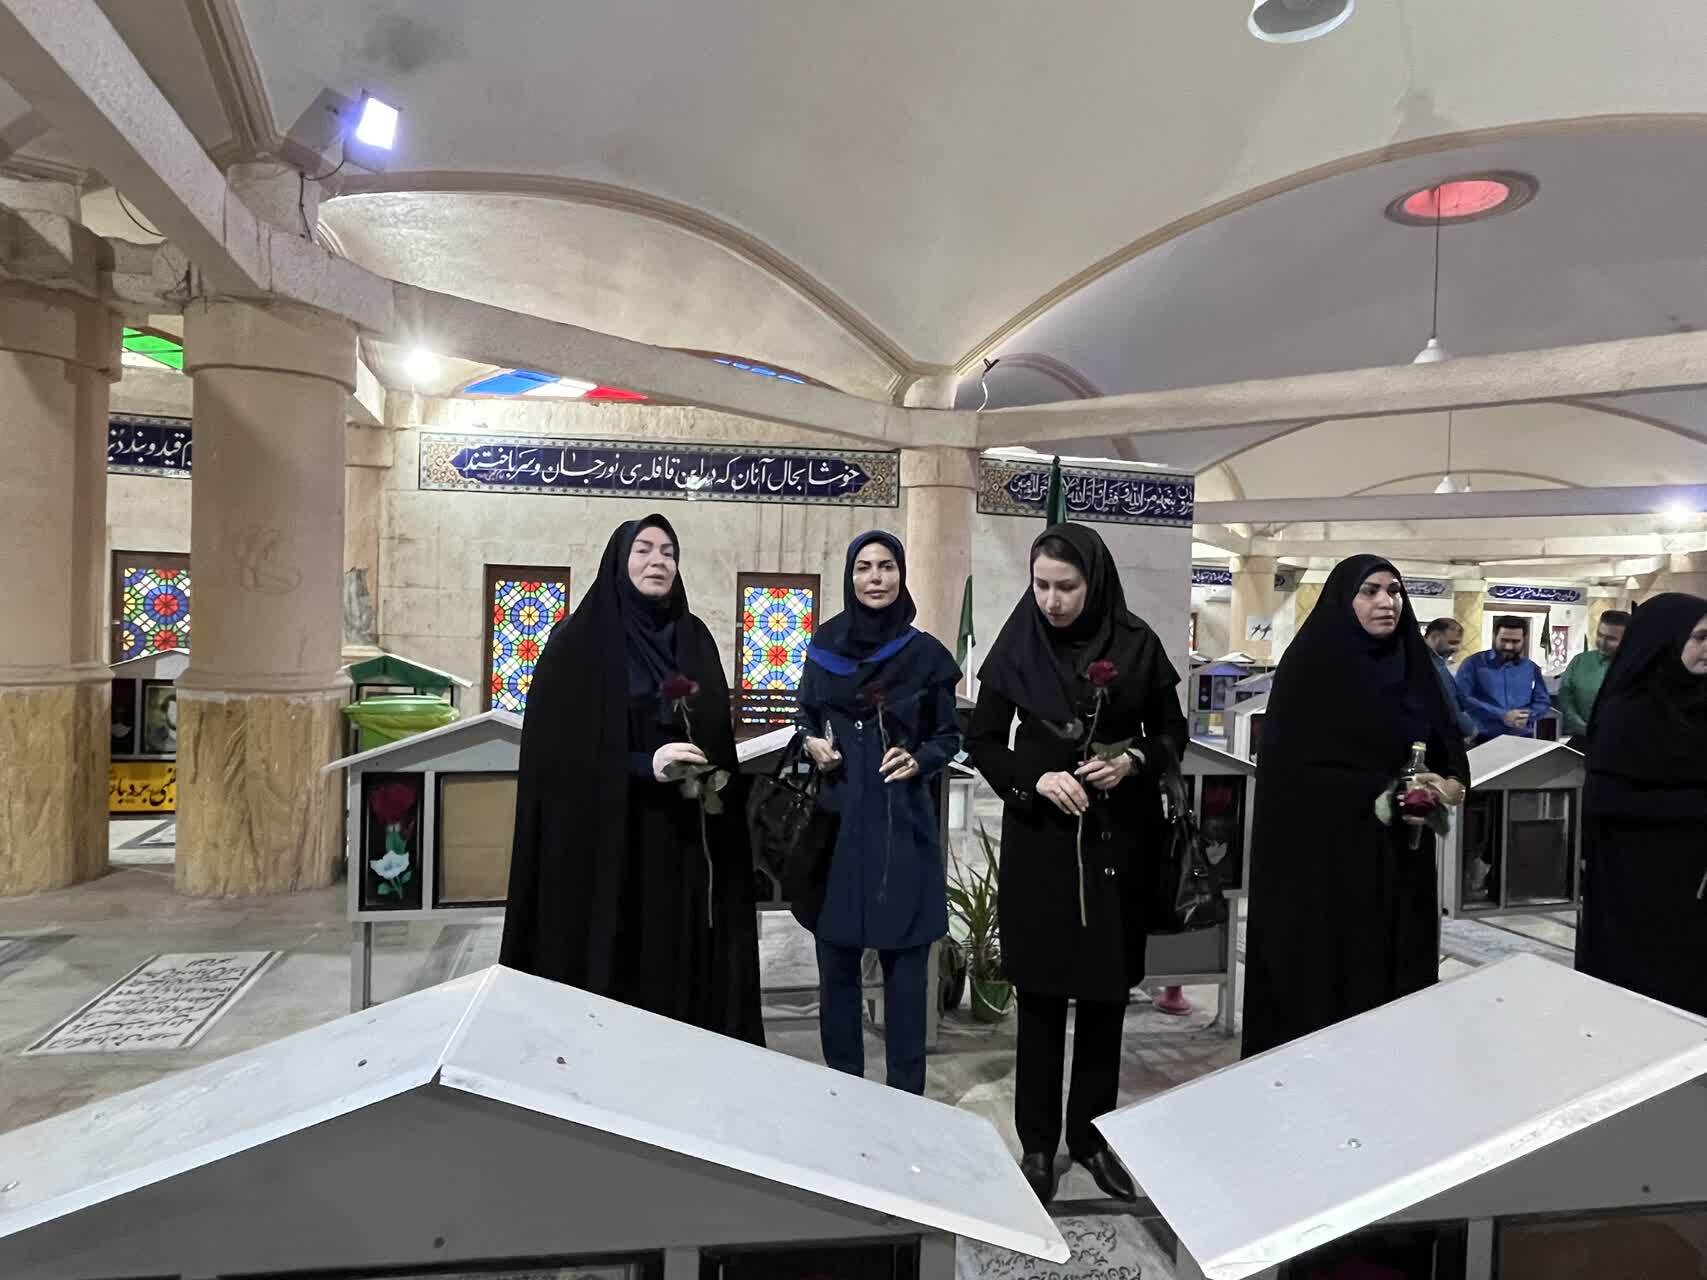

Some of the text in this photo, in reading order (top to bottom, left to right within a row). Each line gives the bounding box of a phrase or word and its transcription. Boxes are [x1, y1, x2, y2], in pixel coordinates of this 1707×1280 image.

[594, 453, 620, 479] نور
[715, 455, 743, 484] که
[731, 456, 774, 490] آنان
[808, 460, 860, 488] خوشا
